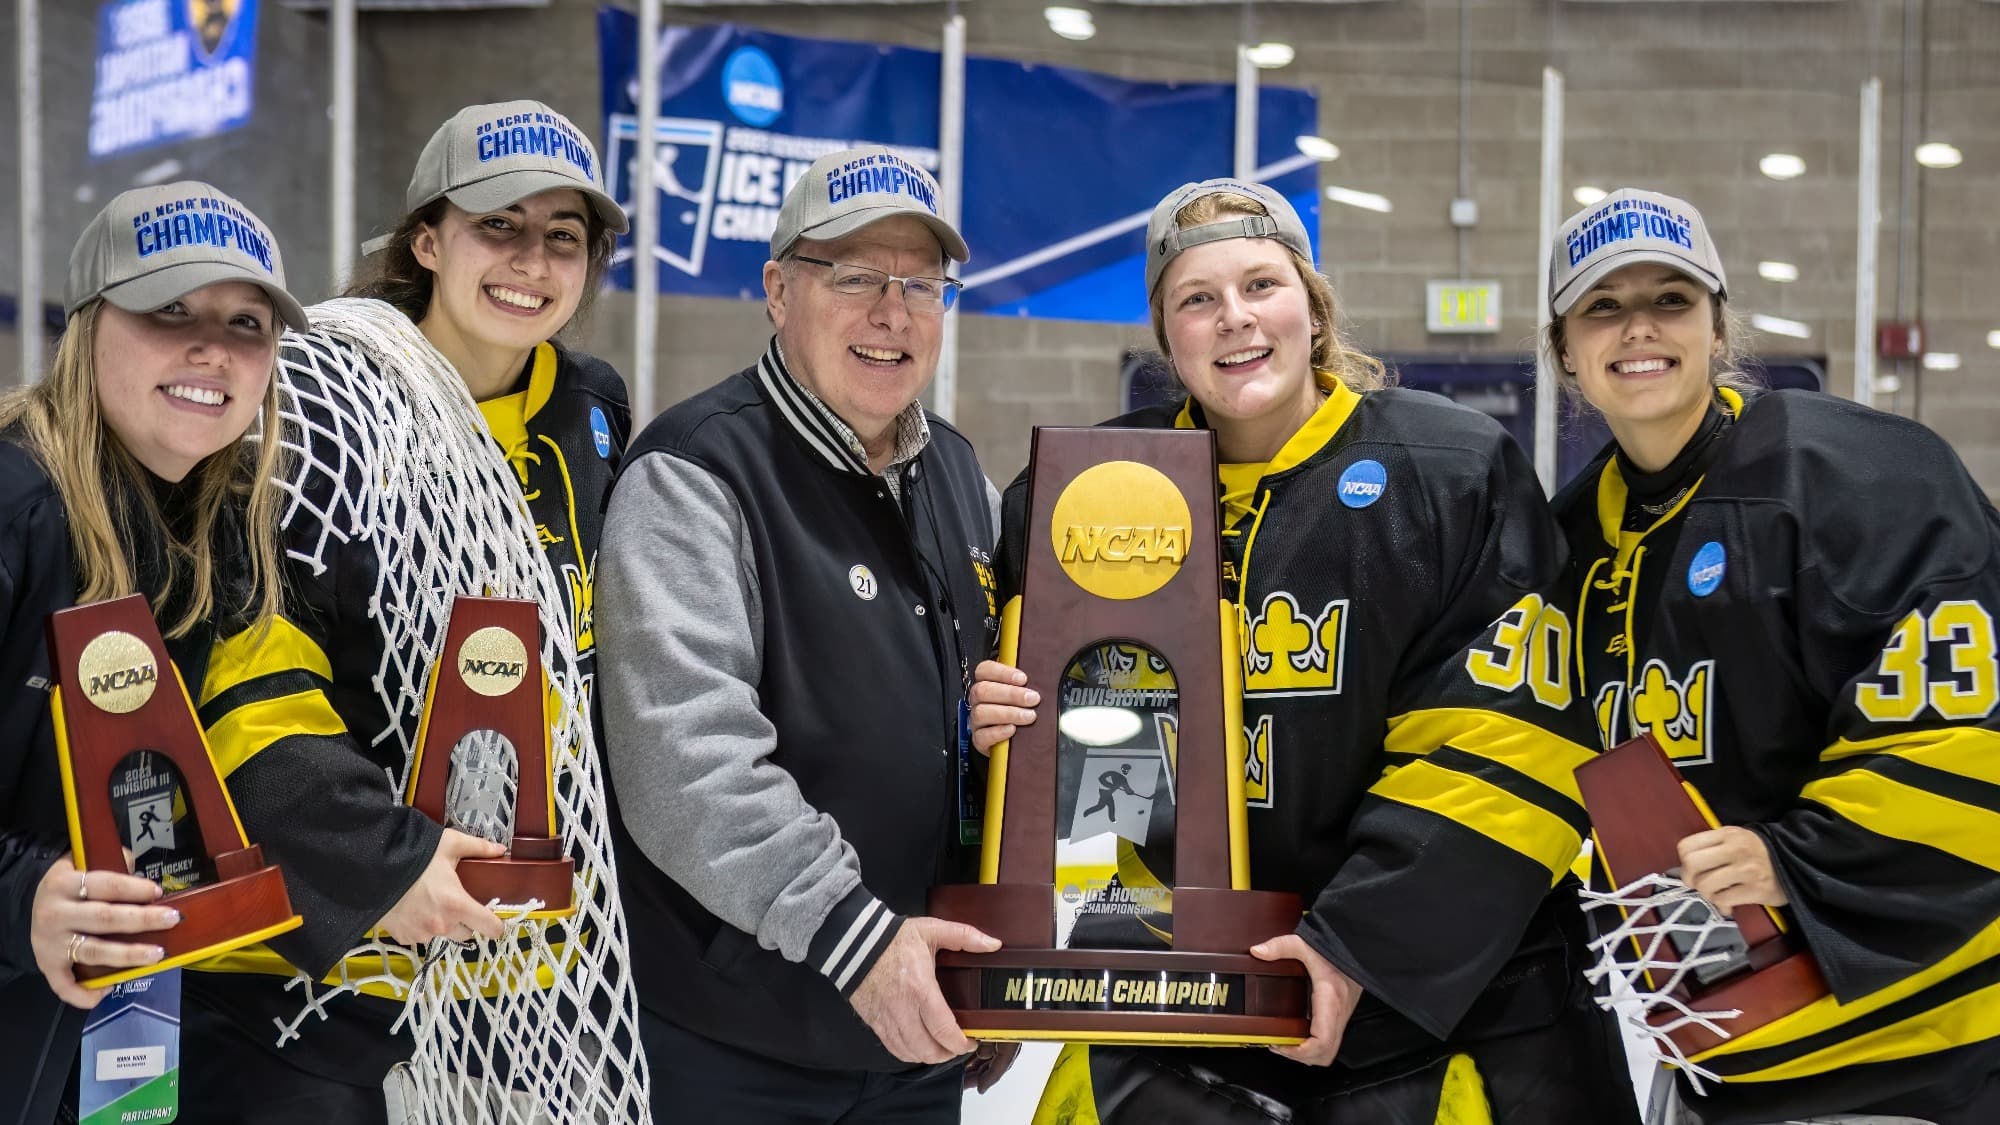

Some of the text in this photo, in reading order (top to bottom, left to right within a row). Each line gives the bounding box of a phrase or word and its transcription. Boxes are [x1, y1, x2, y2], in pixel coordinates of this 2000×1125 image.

[477, 122, 491, 135] 20
[497, 112, 532, 128] NCAA
[536, 112, 583, 147] NATIONAL
[477, 126, 594, 181] CHAMPIONS
[844, 155, 875, 172] NCAA
[878, 154, 926, 183] NATIONAL
[717, 152, 781, 206] ICE
[828, 166, 937, 215] CHAMPIONS
[133, 211, 150, 229] 20
[156, 198, 197, 217] NCAA
[200, 197, 257, 232] NATIONAL
[1581, 205, 1611, 231] NCAA
[1613, 199, 1674, 219] NATIONAL
[135, 211, 273, 275] CHAMPIONS
[1568, 211, 1692, 268] CHAMPIONS
[1440, 288, 1488, 326] EXIT
[1343, 481, 1381, 496] NCAA
[1061, 526, 1187, 565] NCAA
[857, 576, 871, 594] 21
[1465, 593, 1573, 710] 30
[1855, 600, 2000, 721] 33
[90, 664, 156, 696] NCAA
[462, 658, 523, 678] NCAA
[1069, 687, 1170, 708] DIVISION III
[113, 777, 157, 798] DIVISION
[162, 858, 193, 874] HOCKEY
[1084, 887, 1165, 902] ICE HOCKEY
[1005, 978, 1230, 1007] NATIONAL CHAMPION
[121, 1107, 172, 1122] PARTICIPANT
